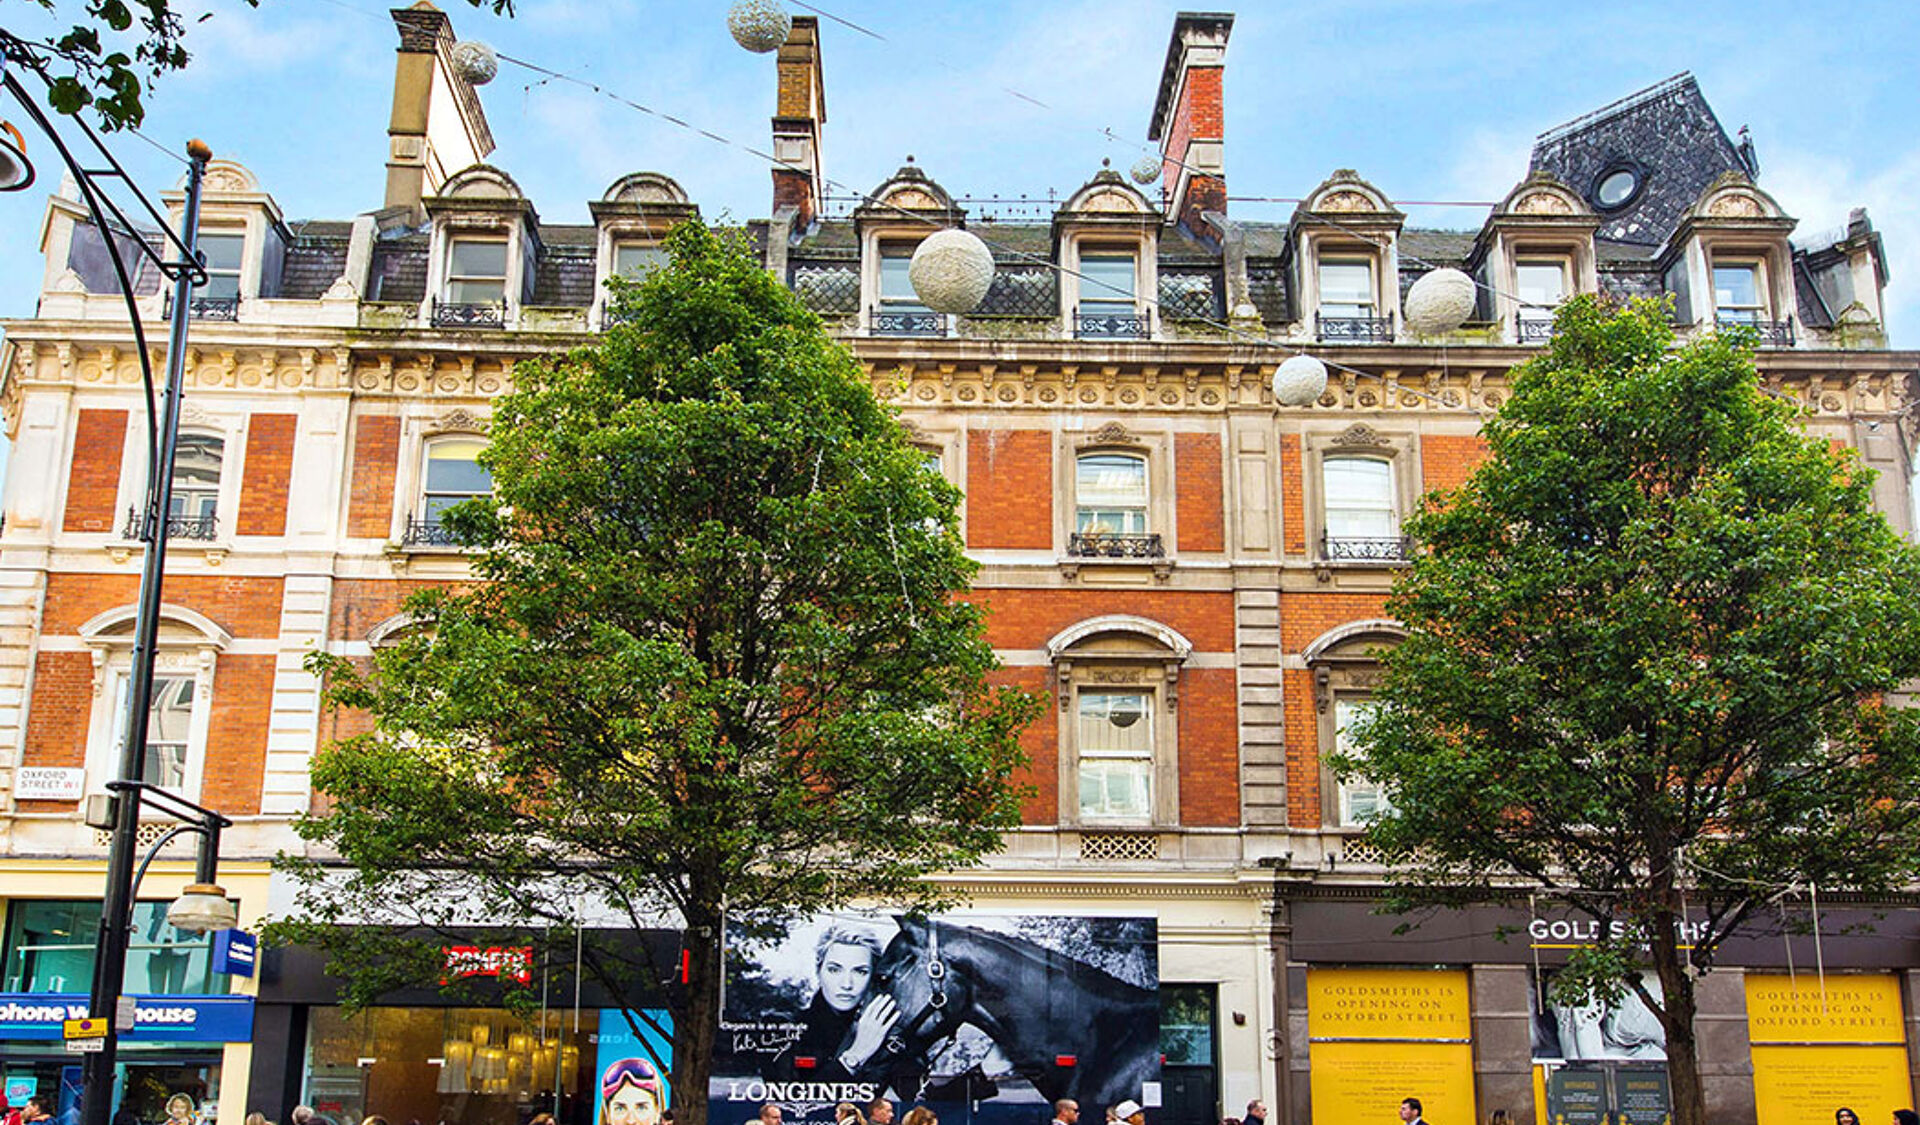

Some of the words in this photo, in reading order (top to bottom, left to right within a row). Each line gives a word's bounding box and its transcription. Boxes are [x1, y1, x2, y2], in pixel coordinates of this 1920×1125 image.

[21, 770, 68, 779] OXFORD
[20, 780, 60, 789] STREET
[1322, 986, 1431, 997] GOLDSMITHS
[1439, 988, 1455, 997] IS
[1755, 991, 1862, 1001] GOLDSMITHS
[1868, 991, 1884, 1001] IS
[1336, 1000, 1411, 1010] OPENING
[1418, 1000, 1442, 1010] ON
[1850, 1004, 1873, 1014] ON
[1321, 1012, 1389, 1022] OXFORD
[1755, 1017, 1822, 1027] OXFORD
[728, 1081, 876, 1102] LONGINES
